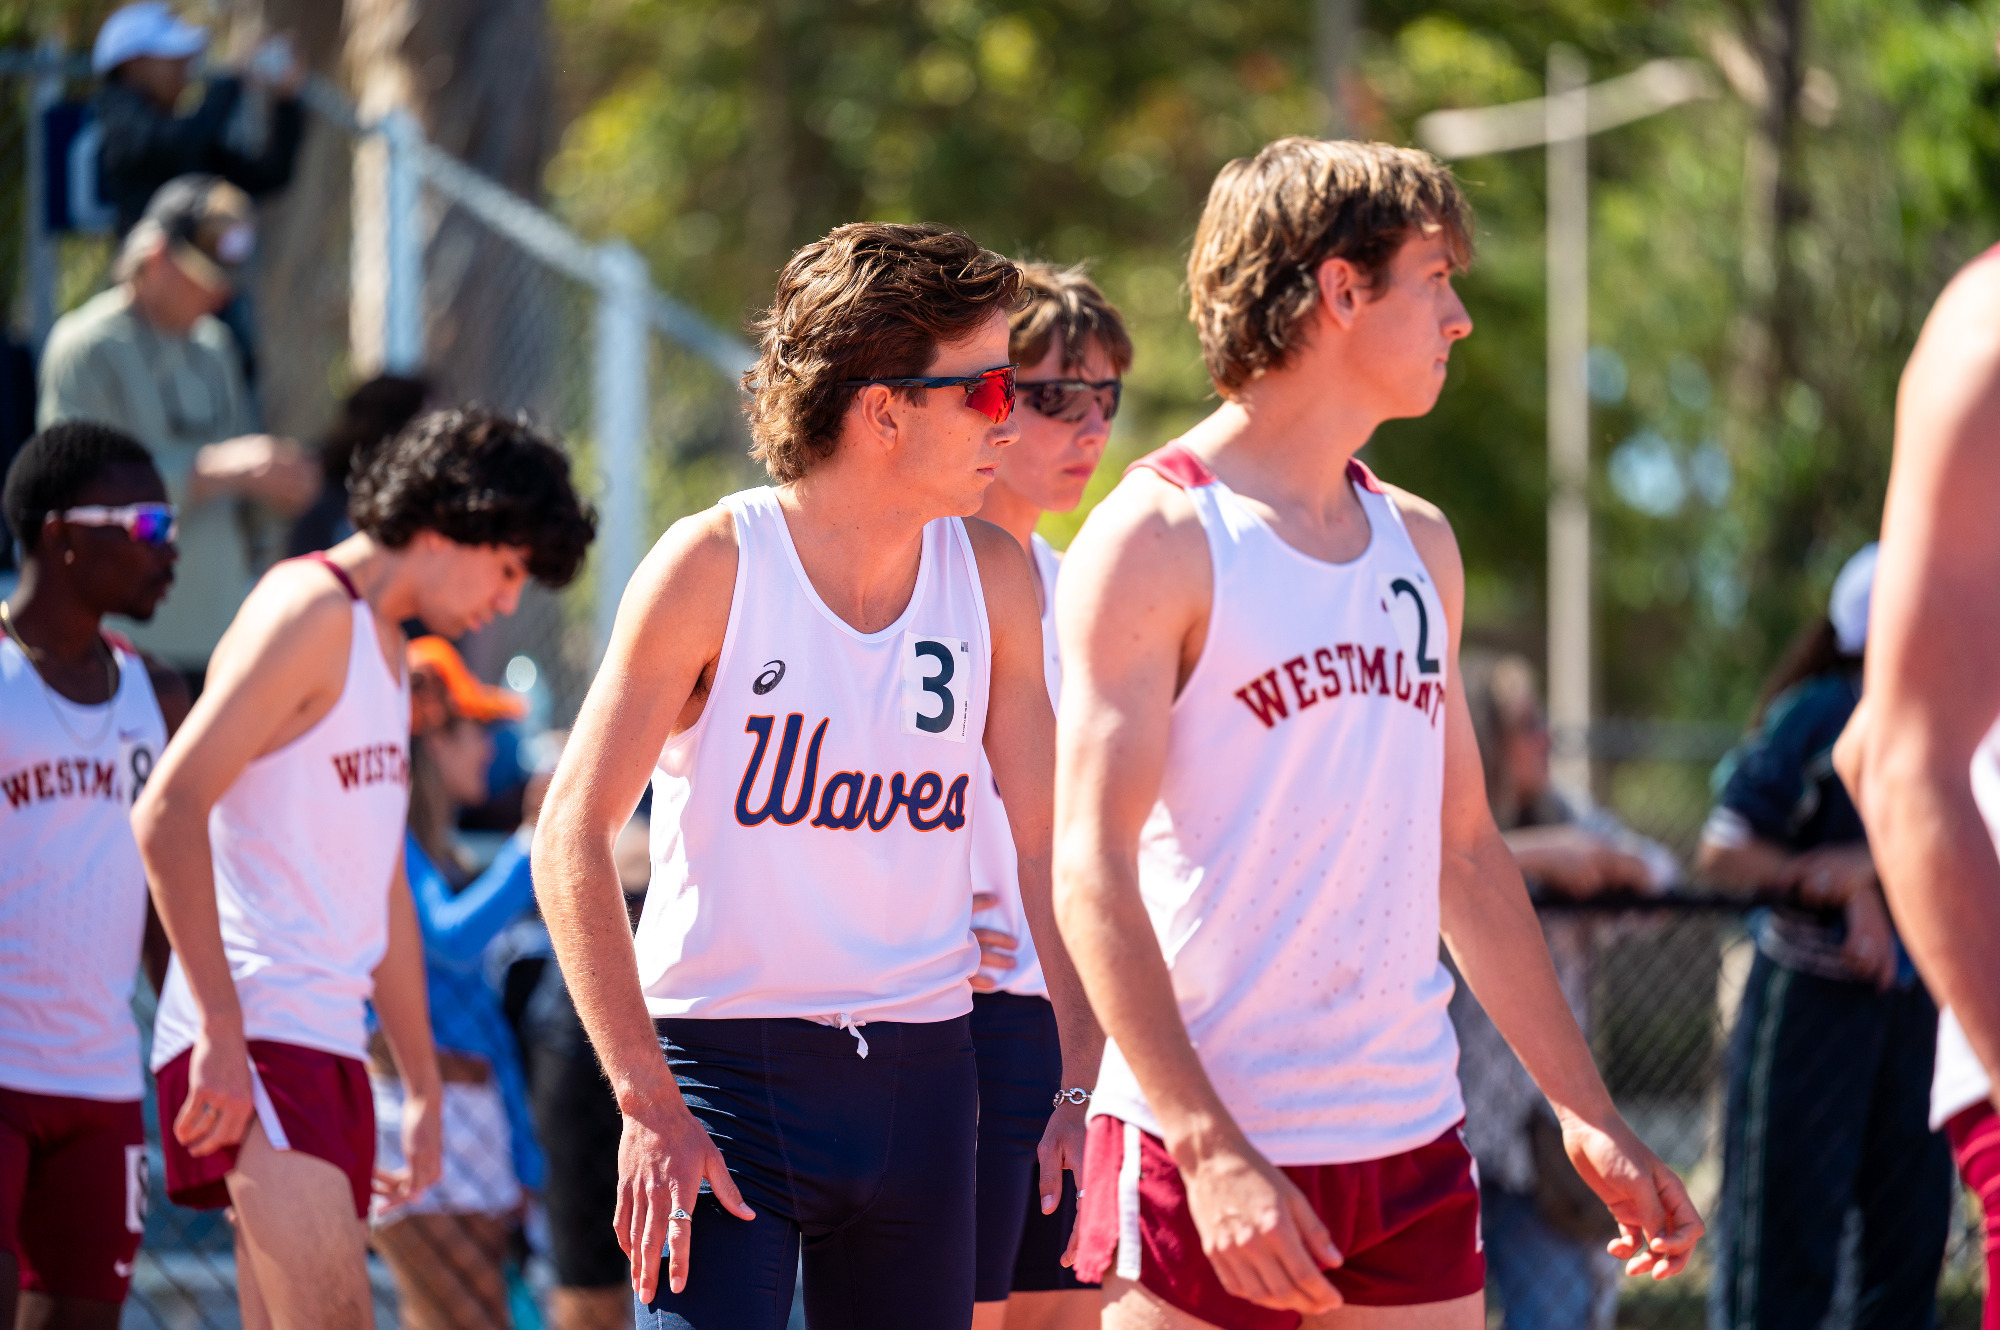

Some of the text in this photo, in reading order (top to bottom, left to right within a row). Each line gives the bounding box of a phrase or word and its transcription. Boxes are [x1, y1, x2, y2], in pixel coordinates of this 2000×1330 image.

[1390, 577, 1440, 674] 2
[914, 640, 955, 734] 3
[1, 757, 123, 812] WESTM
[734, 712, 969, 832] Waves
